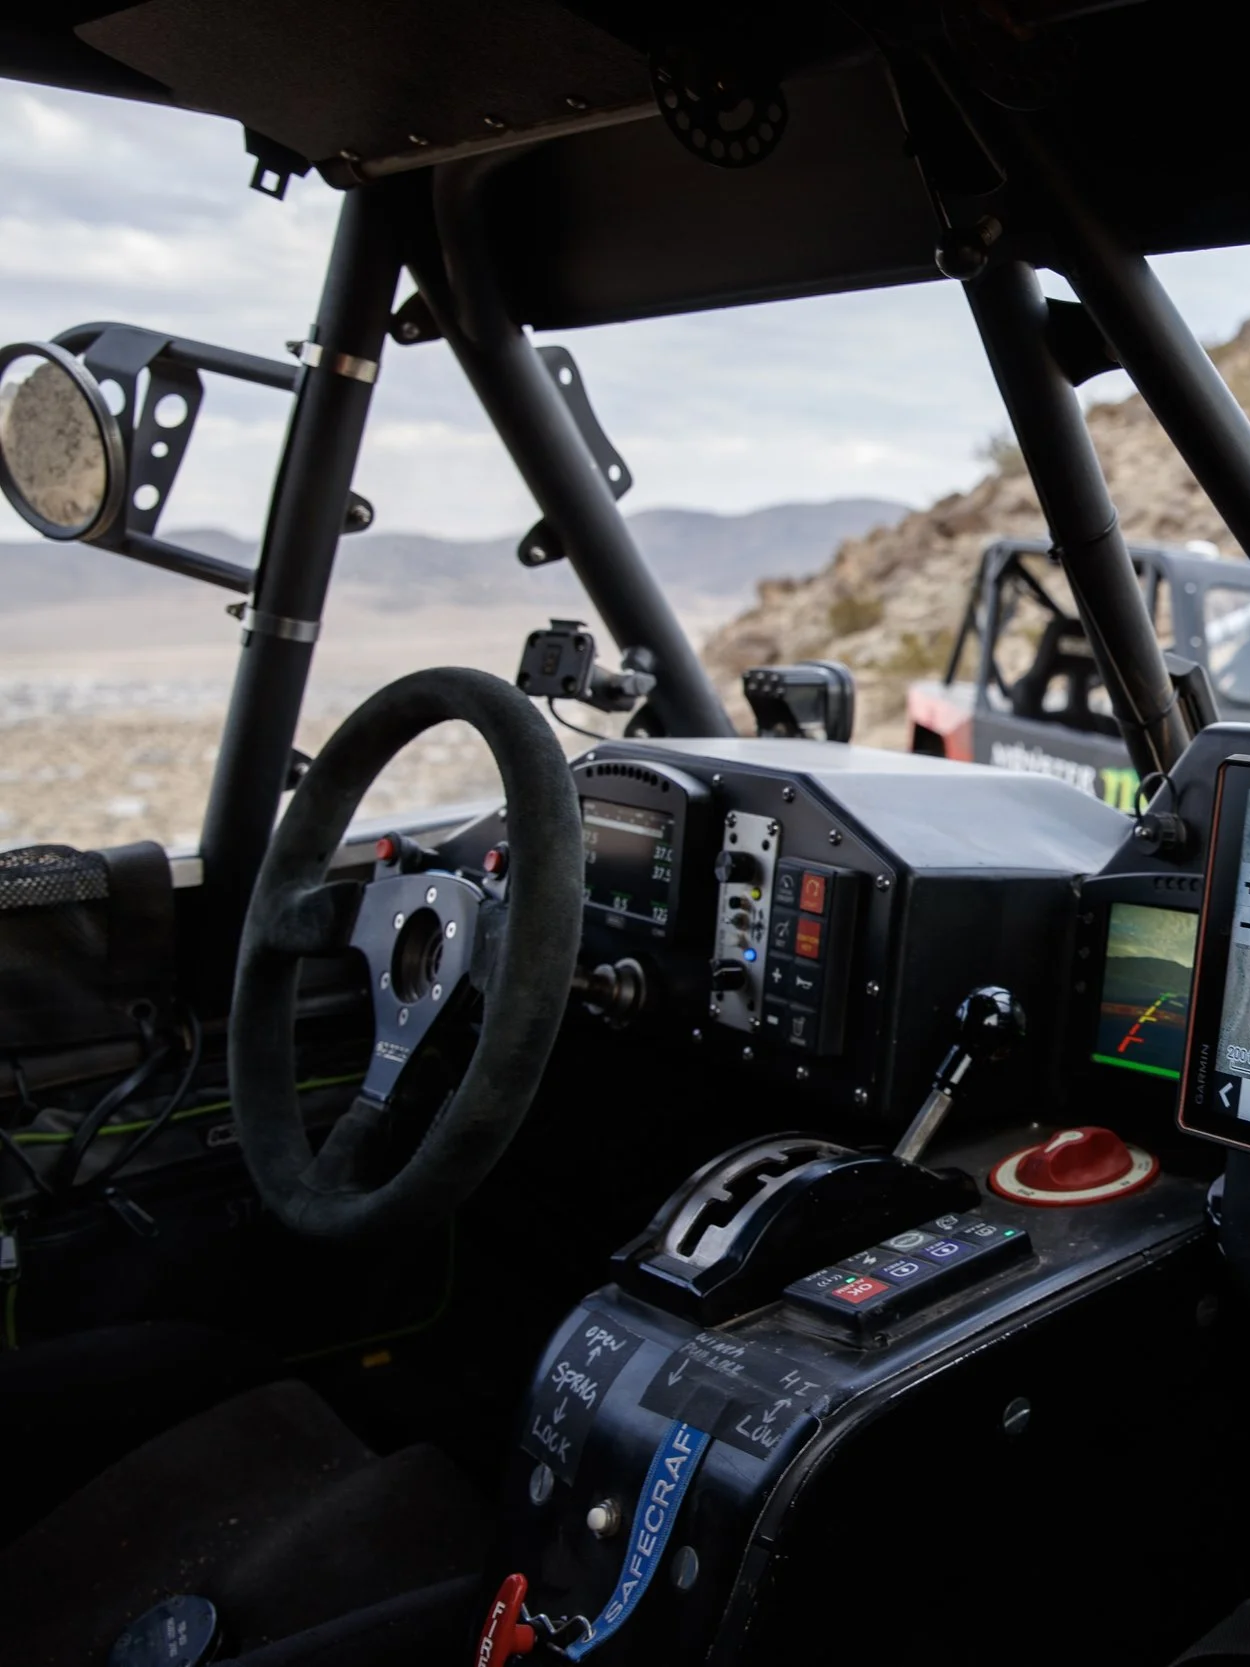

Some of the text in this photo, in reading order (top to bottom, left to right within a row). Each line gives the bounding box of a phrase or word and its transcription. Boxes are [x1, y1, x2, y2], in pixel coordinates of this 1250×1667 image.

[1227, 1045, 1246, 1062] 200
[779, 1369, 820, 1398] HI
[531, 1414, 572, 1463] LOCK
[734, 1414, 783, 1449] LOW
[604, 1422, 695, 1623] SAFECRAF
